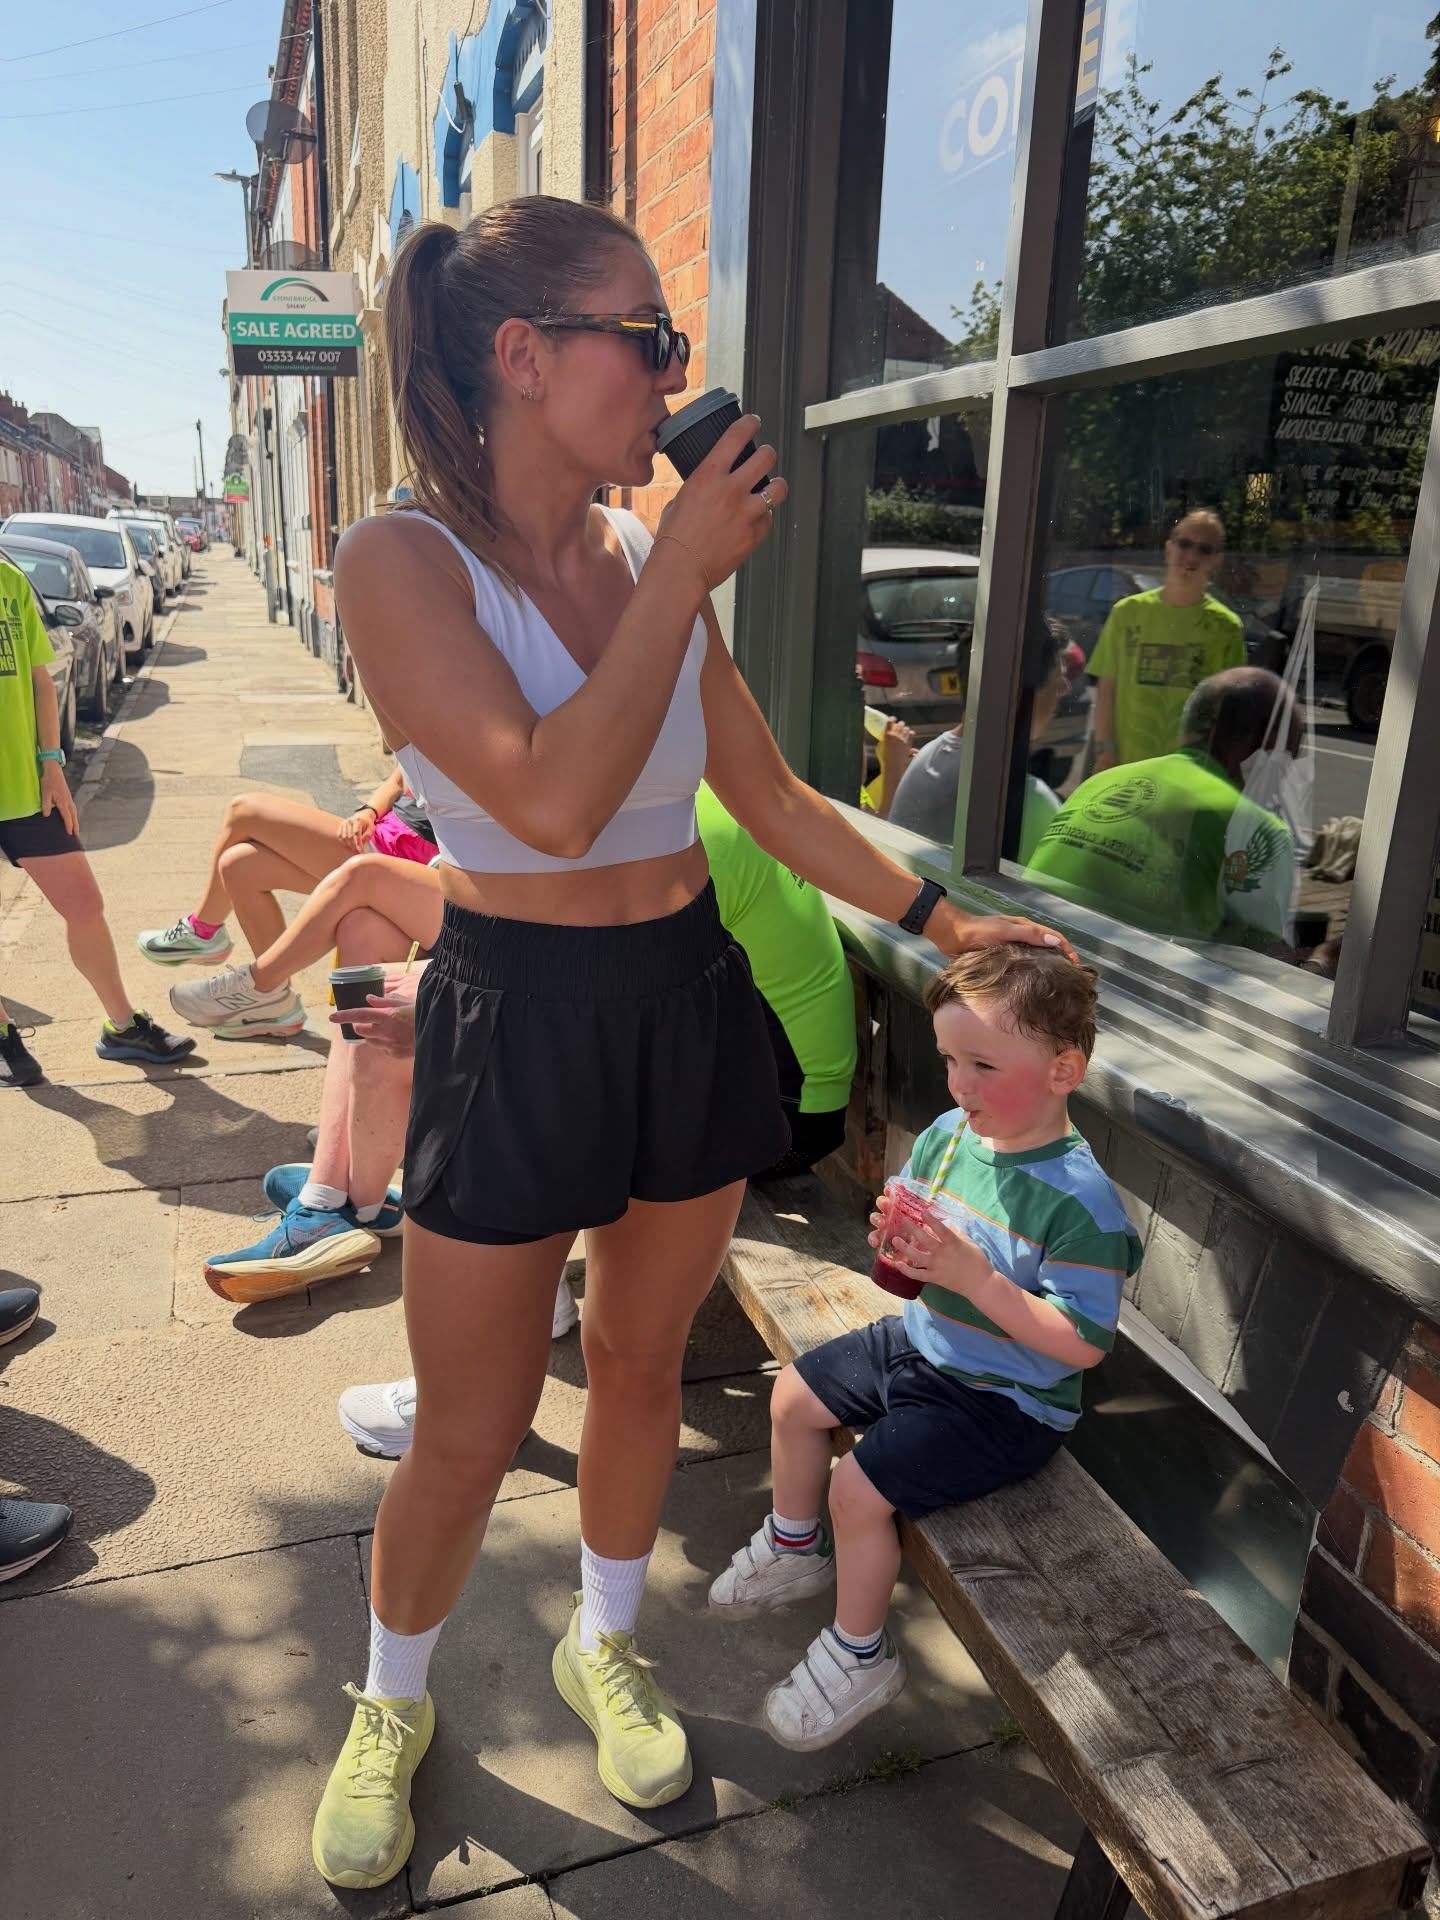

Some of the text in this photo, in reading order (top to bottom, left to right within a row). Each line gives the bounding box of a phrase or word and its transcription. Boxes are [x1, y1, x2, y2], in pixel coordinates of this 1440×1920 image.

[236, 321, 357, 339] SALE AGREED
[257, 350, 341, 363] 03333 447 007
[1285, 365, 1388, 393] SELECT FROM
[1280, 390, 1338, 416] SINGLE
[1274, 417, 1366, 445] HOUSEBLEND
